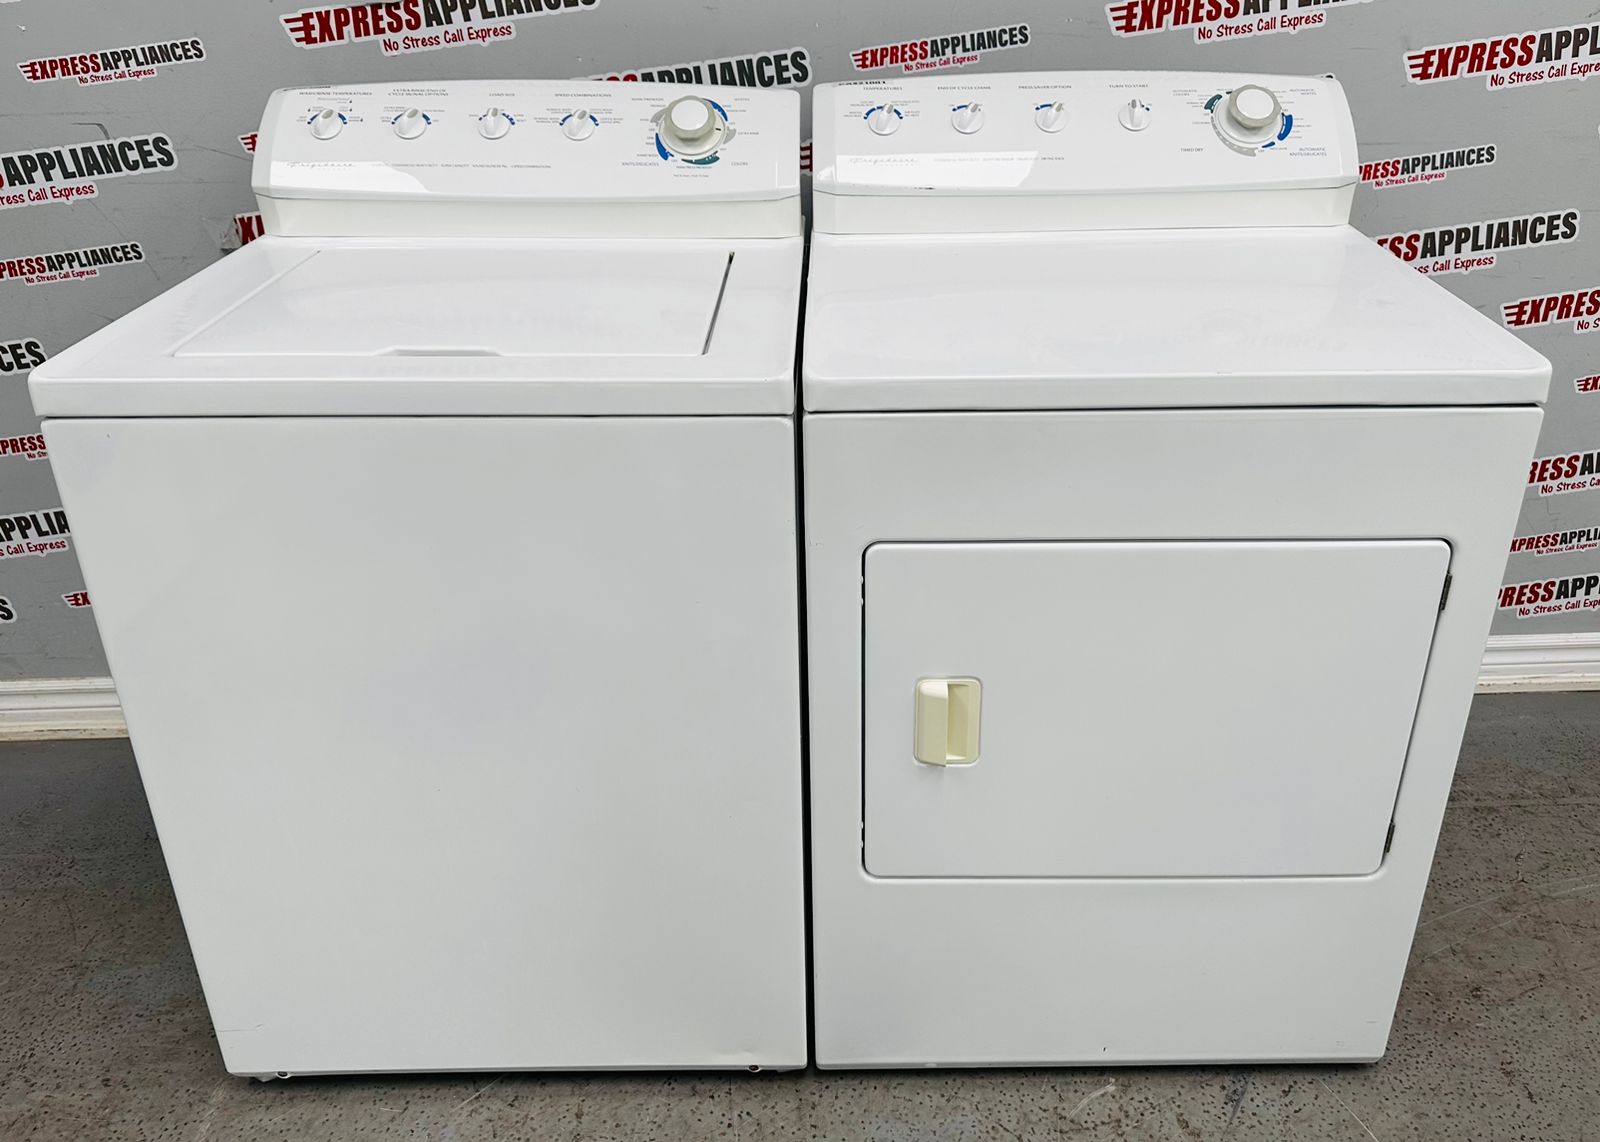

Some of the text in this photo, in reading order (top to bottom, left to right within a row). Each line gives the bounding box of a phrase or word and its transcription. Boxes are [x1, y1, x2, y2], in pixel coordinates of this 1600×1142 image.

[1198, 13, 1323, 40] No Stress Call Express
[383, 25, 512, 52] No Stress Call Express
[904, 54, 978, 72] No Stress Call Express
[78, 68, 155, 84] No Stress Call Express
[1490, 74, 1504, 87] No
[1508, 70, 1544, 85] Stress
[1548, 65, 1567, 78] Call
[0, 136, 174, 191] APPLIANCES
[1374, 171, 1445, 188] No Stress Call Express
[28, 186, 47, 202] Call
[50, 183, 95, 201] Express
[1432, 260, 1450, 273] Call
[1454, 255, 1494, 272] Express
[25, 268, 97, 284] No Stress Call Express
[1577, 319, 1589, 331] No
[0, 434, 46, 455] PRESS
[1541, 484, 1553, 494] No
[1556, 479, 1586, 492] Stress
[0, 510, 70, 543] PPLIA
[6, 544, 25, 556] Call
[26, 540, 67, 554] Express
[1545, 546, 1563, 554] Stress
[1576, 541, 1598, 551] Express
[1518, 607, 1530, 617] No
[1533, 603, 1562, 615] Stress
[1565, 599, 1581, 610] Call
